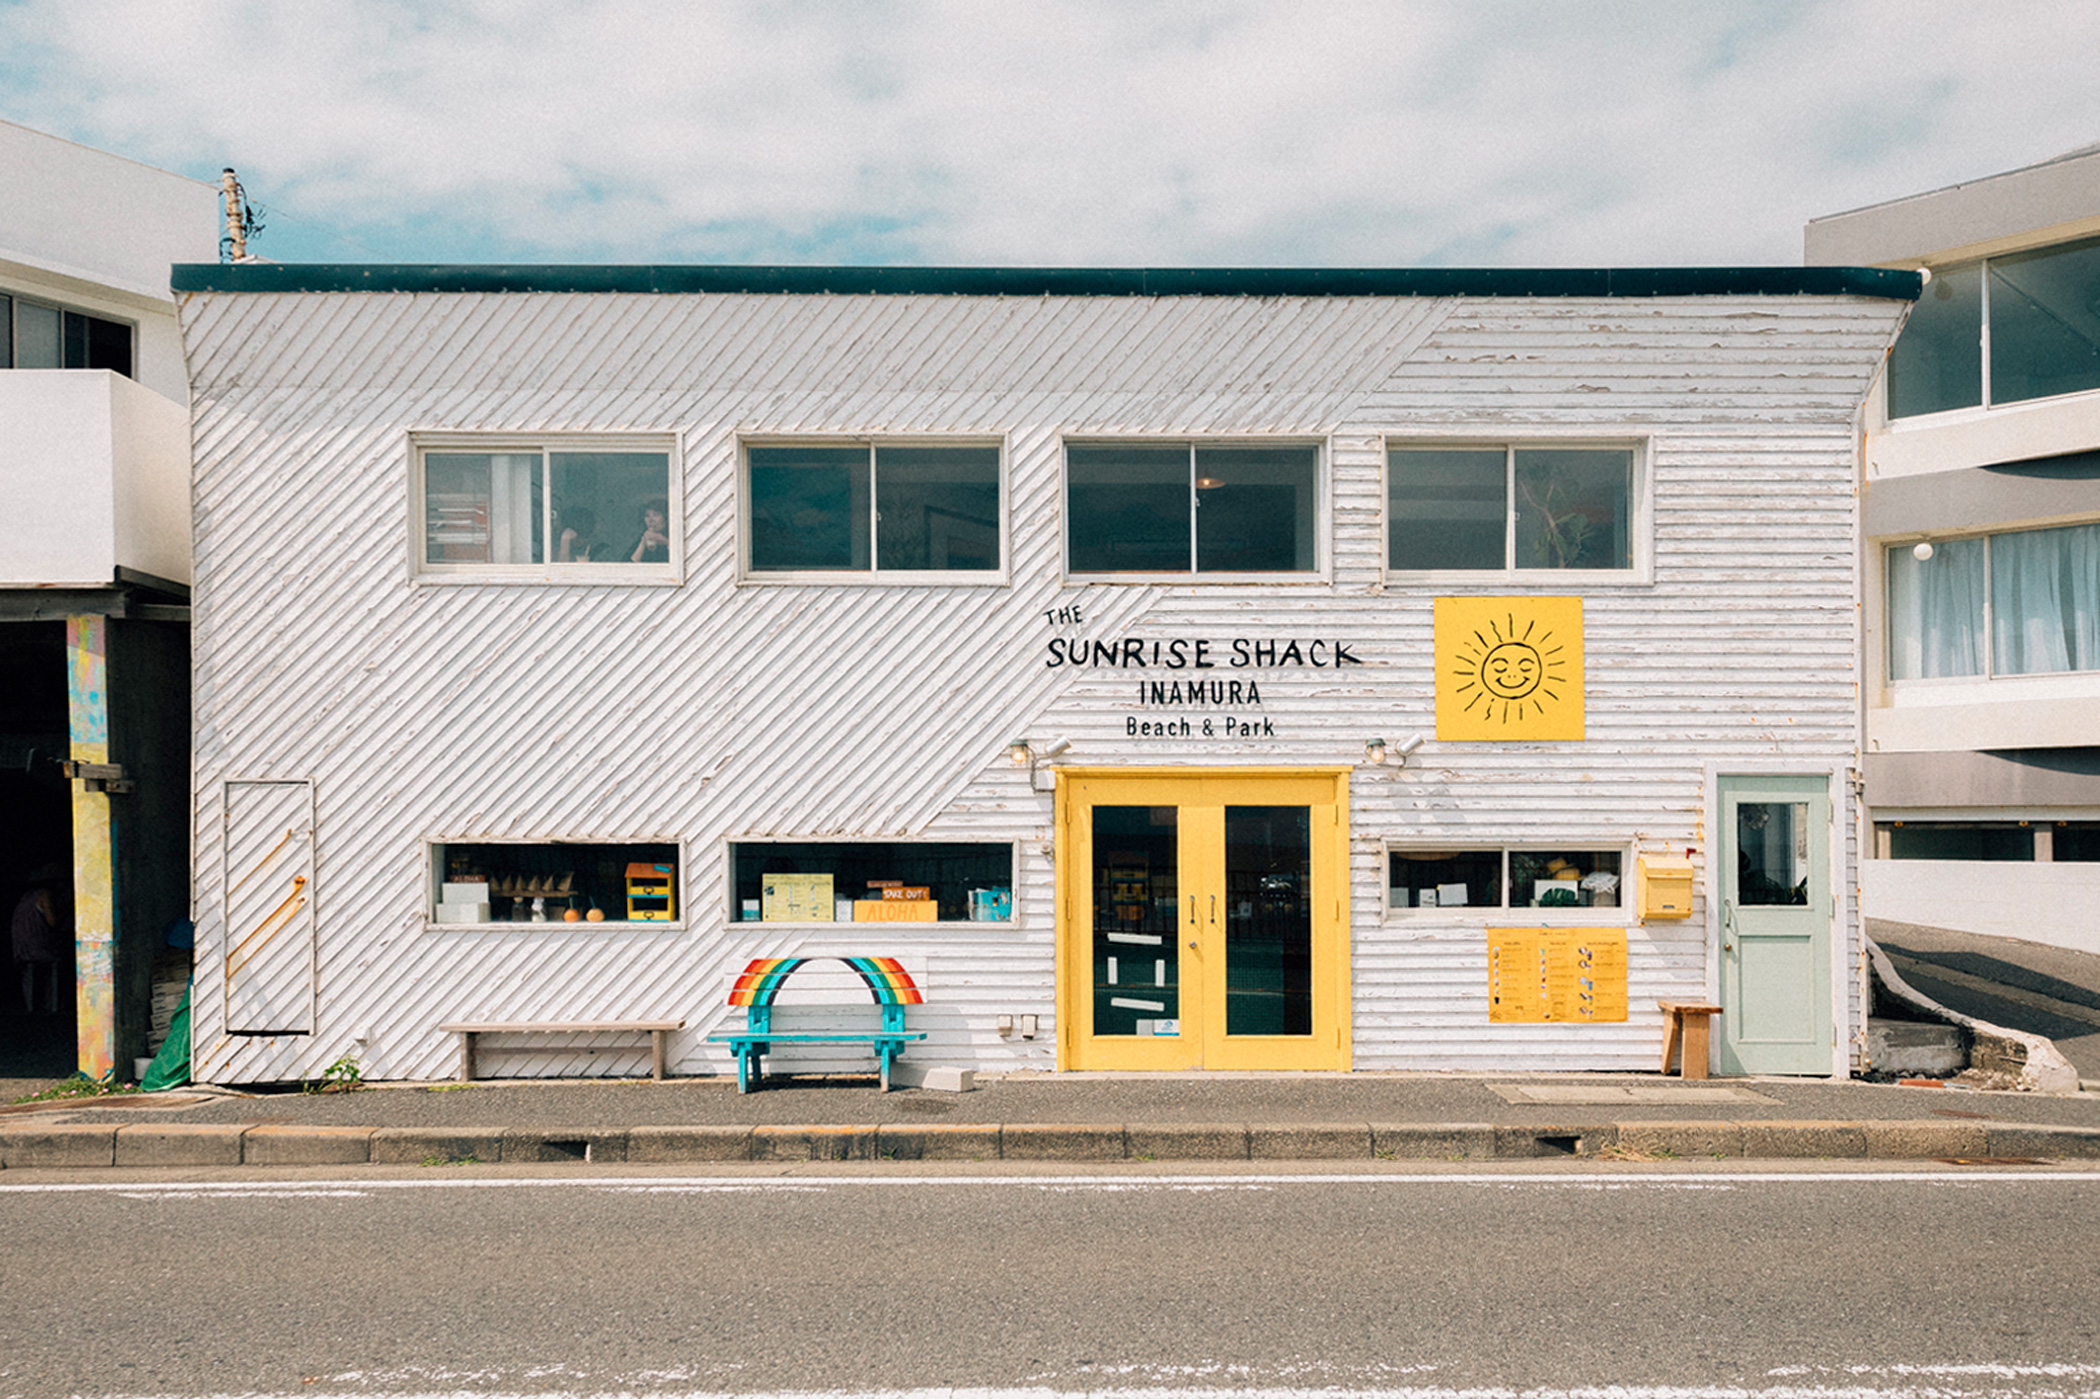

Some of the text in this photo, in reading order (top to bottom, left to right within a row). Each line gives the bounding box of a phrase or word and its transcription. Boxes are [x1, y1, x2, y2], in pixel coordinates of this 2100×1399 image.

[1043, 605, 1083, 625] THE
[1046, 638, 1363, 669] SUNRISE SHACK
[1140, 680, 1262, 705] INAMURA
[1126, 717, 1275, 737] Beach & Park
[883, 889, 904, 899] TAKE
[866, 903, 919, 921] ALOHA
